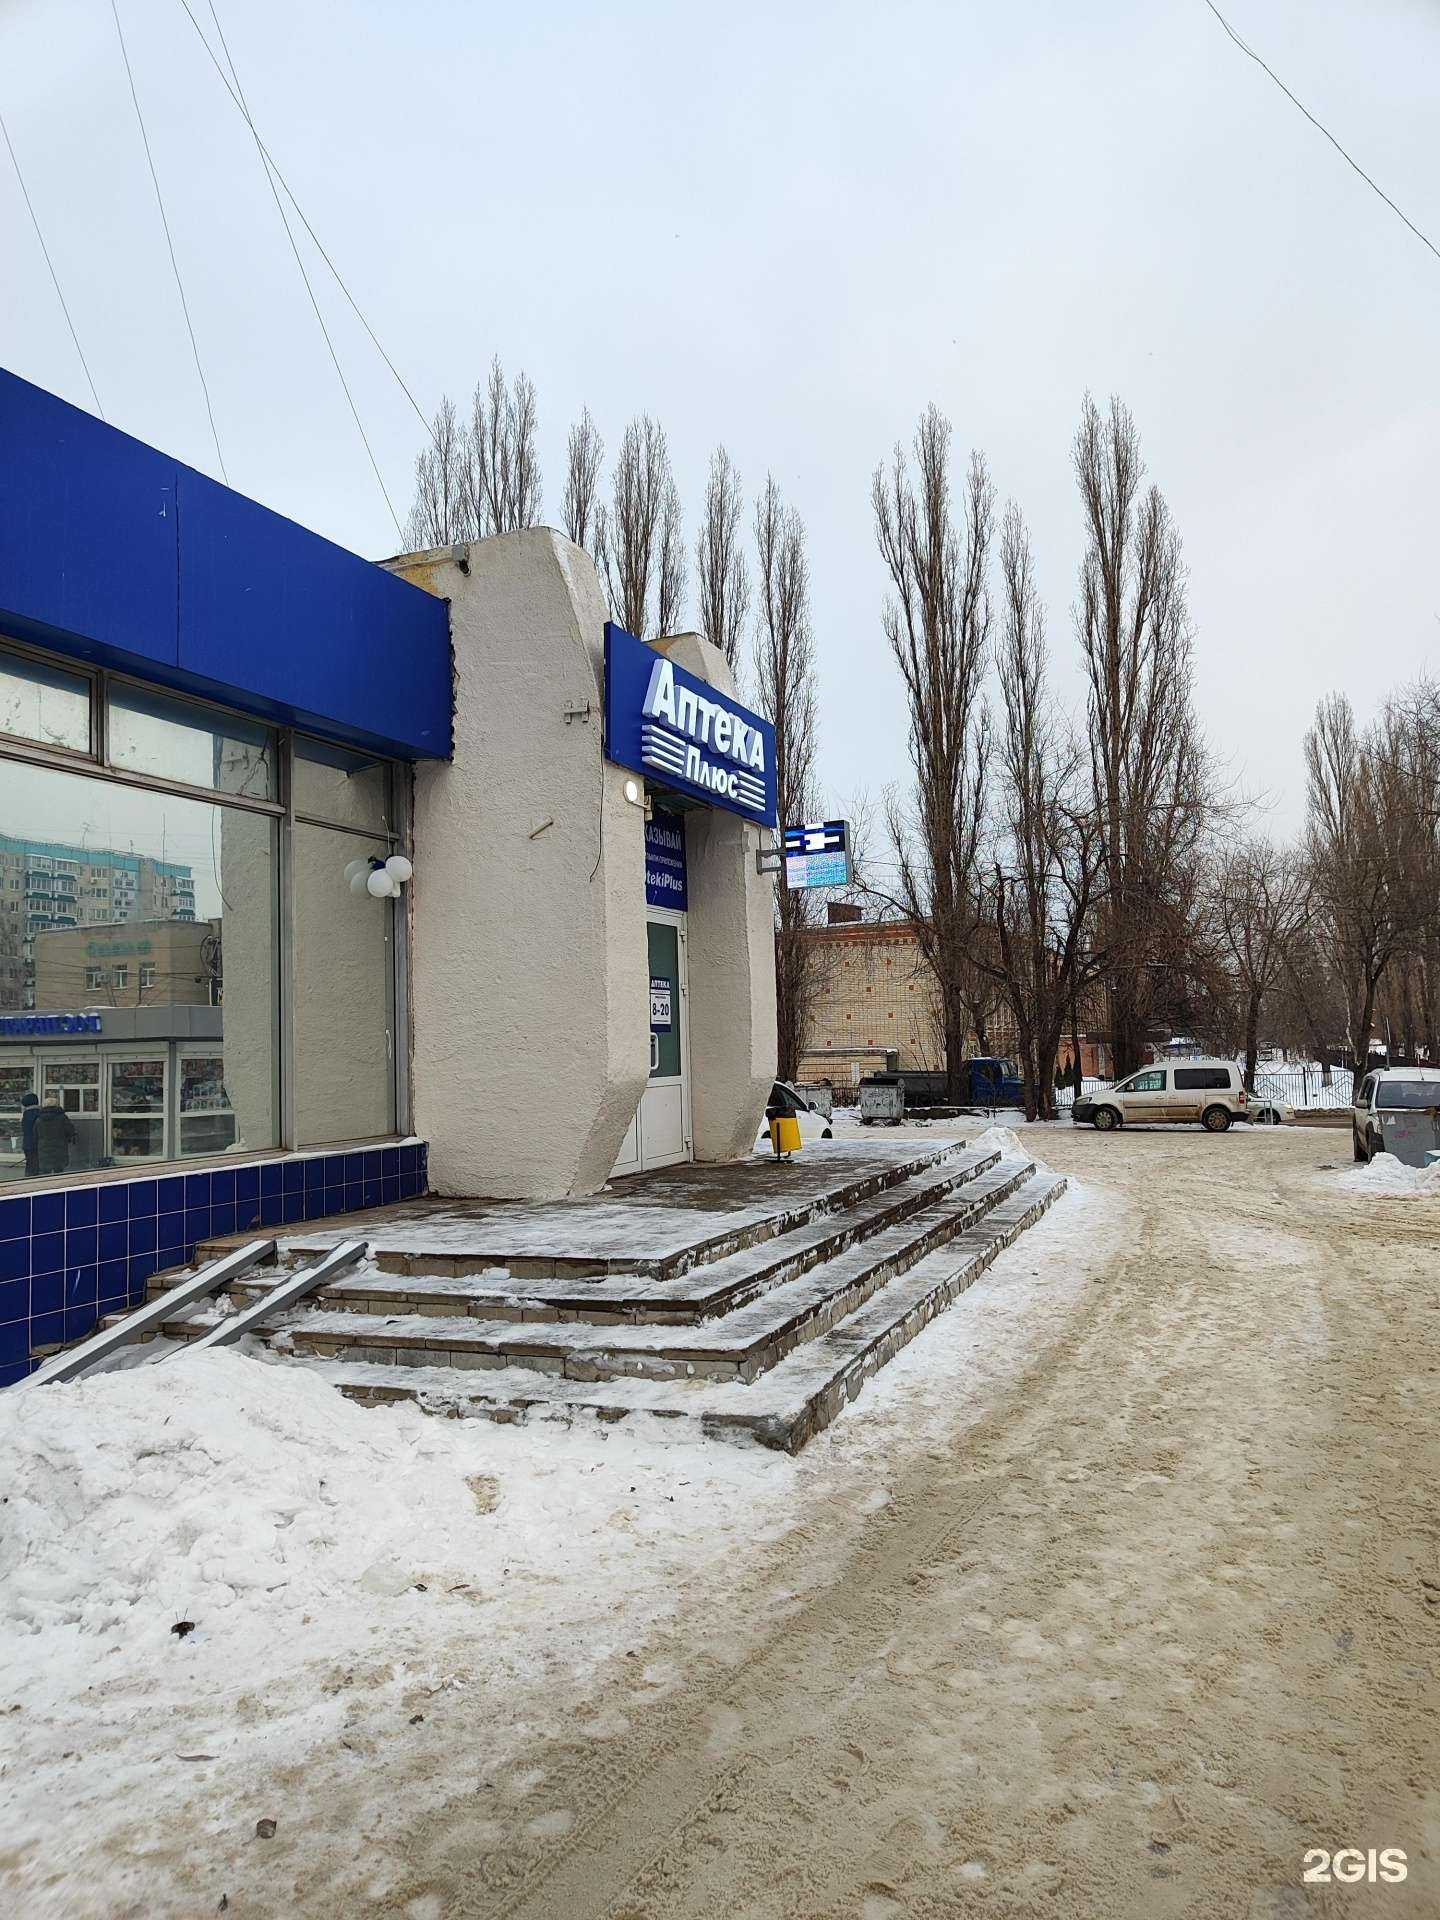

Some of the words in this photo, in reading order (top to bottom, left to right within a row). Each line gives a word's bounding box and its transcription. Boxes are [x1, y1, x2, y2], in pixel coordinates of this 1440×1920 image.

[643, 659, 765, 773] Аптека
[683, 744, 738, 799] Плюс
[652, 1003, 670, 1016] 8-20
